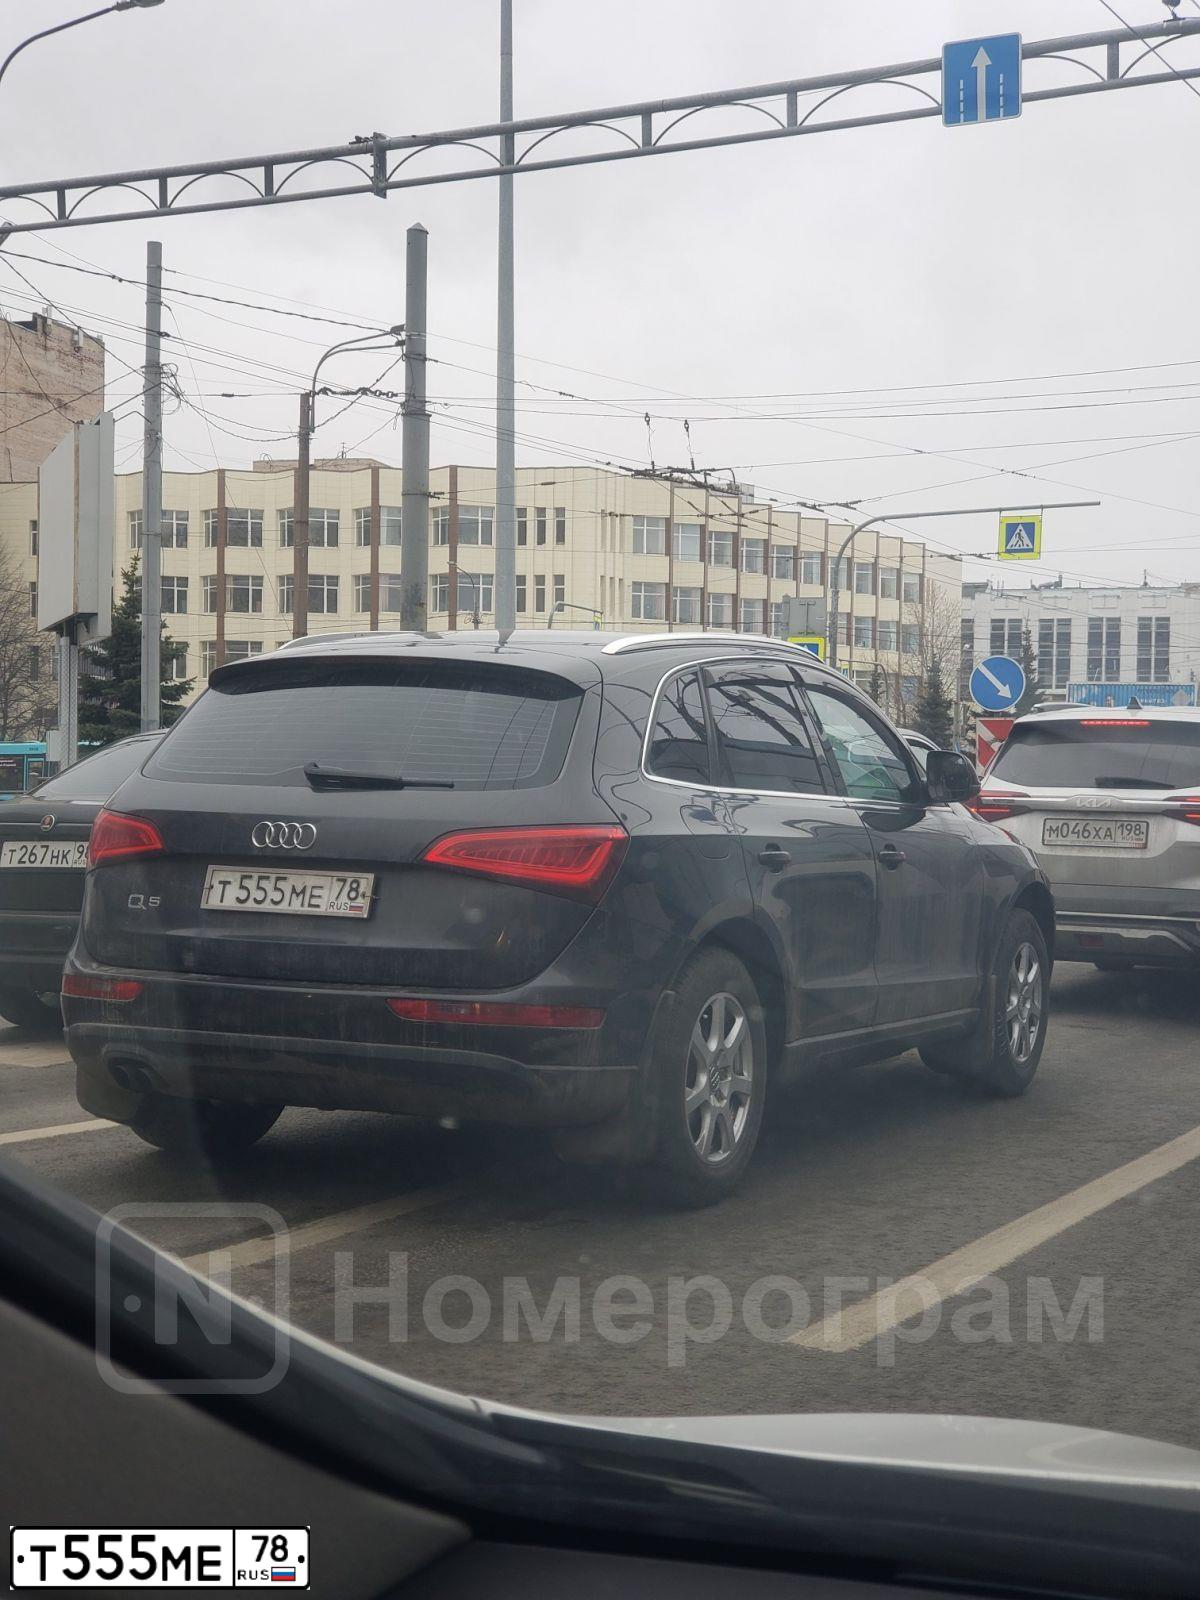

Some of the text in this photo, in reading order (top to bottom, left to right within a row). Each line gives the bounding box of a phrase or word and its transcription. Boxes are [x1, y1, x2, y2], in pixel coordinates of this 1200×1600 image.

[1048, 822, 1142, 840] М046ХА 198
[8, 844, 71, 865] Т267НК
[218, 875, 361, 909] Т555МЕ 78
[128, 894, 161, 910] Q5
[328, 901, 349, 911] RUS
